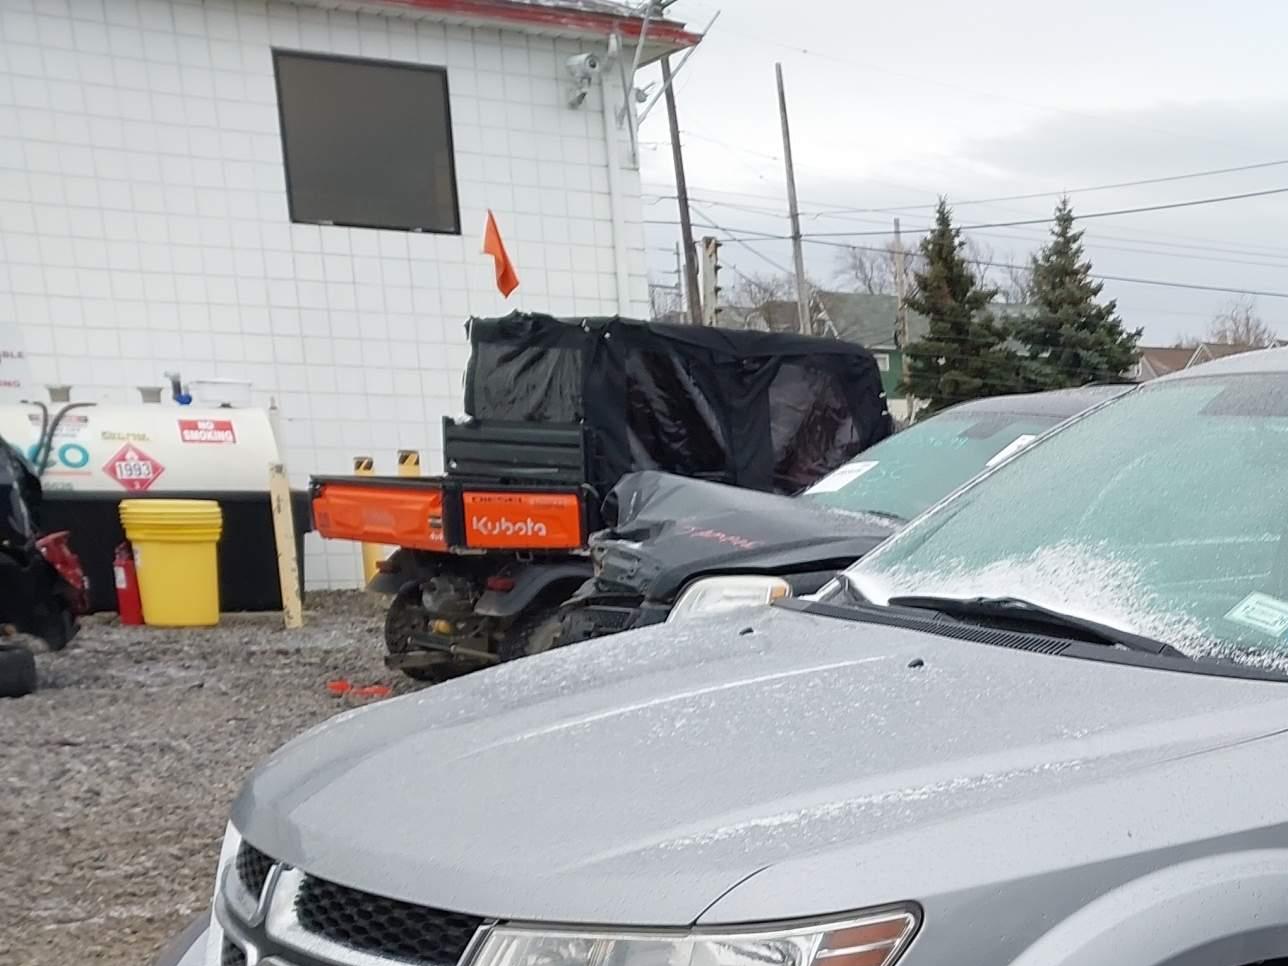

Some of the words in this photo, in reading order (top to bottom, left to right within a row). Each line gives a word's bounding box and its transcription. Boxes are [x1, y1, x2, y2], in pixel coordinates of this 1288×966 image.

[183, 429, 233, 441] SMOKING
[118, 463, 152, 477] 1993
[472, 515, 547, 536] Kubota
